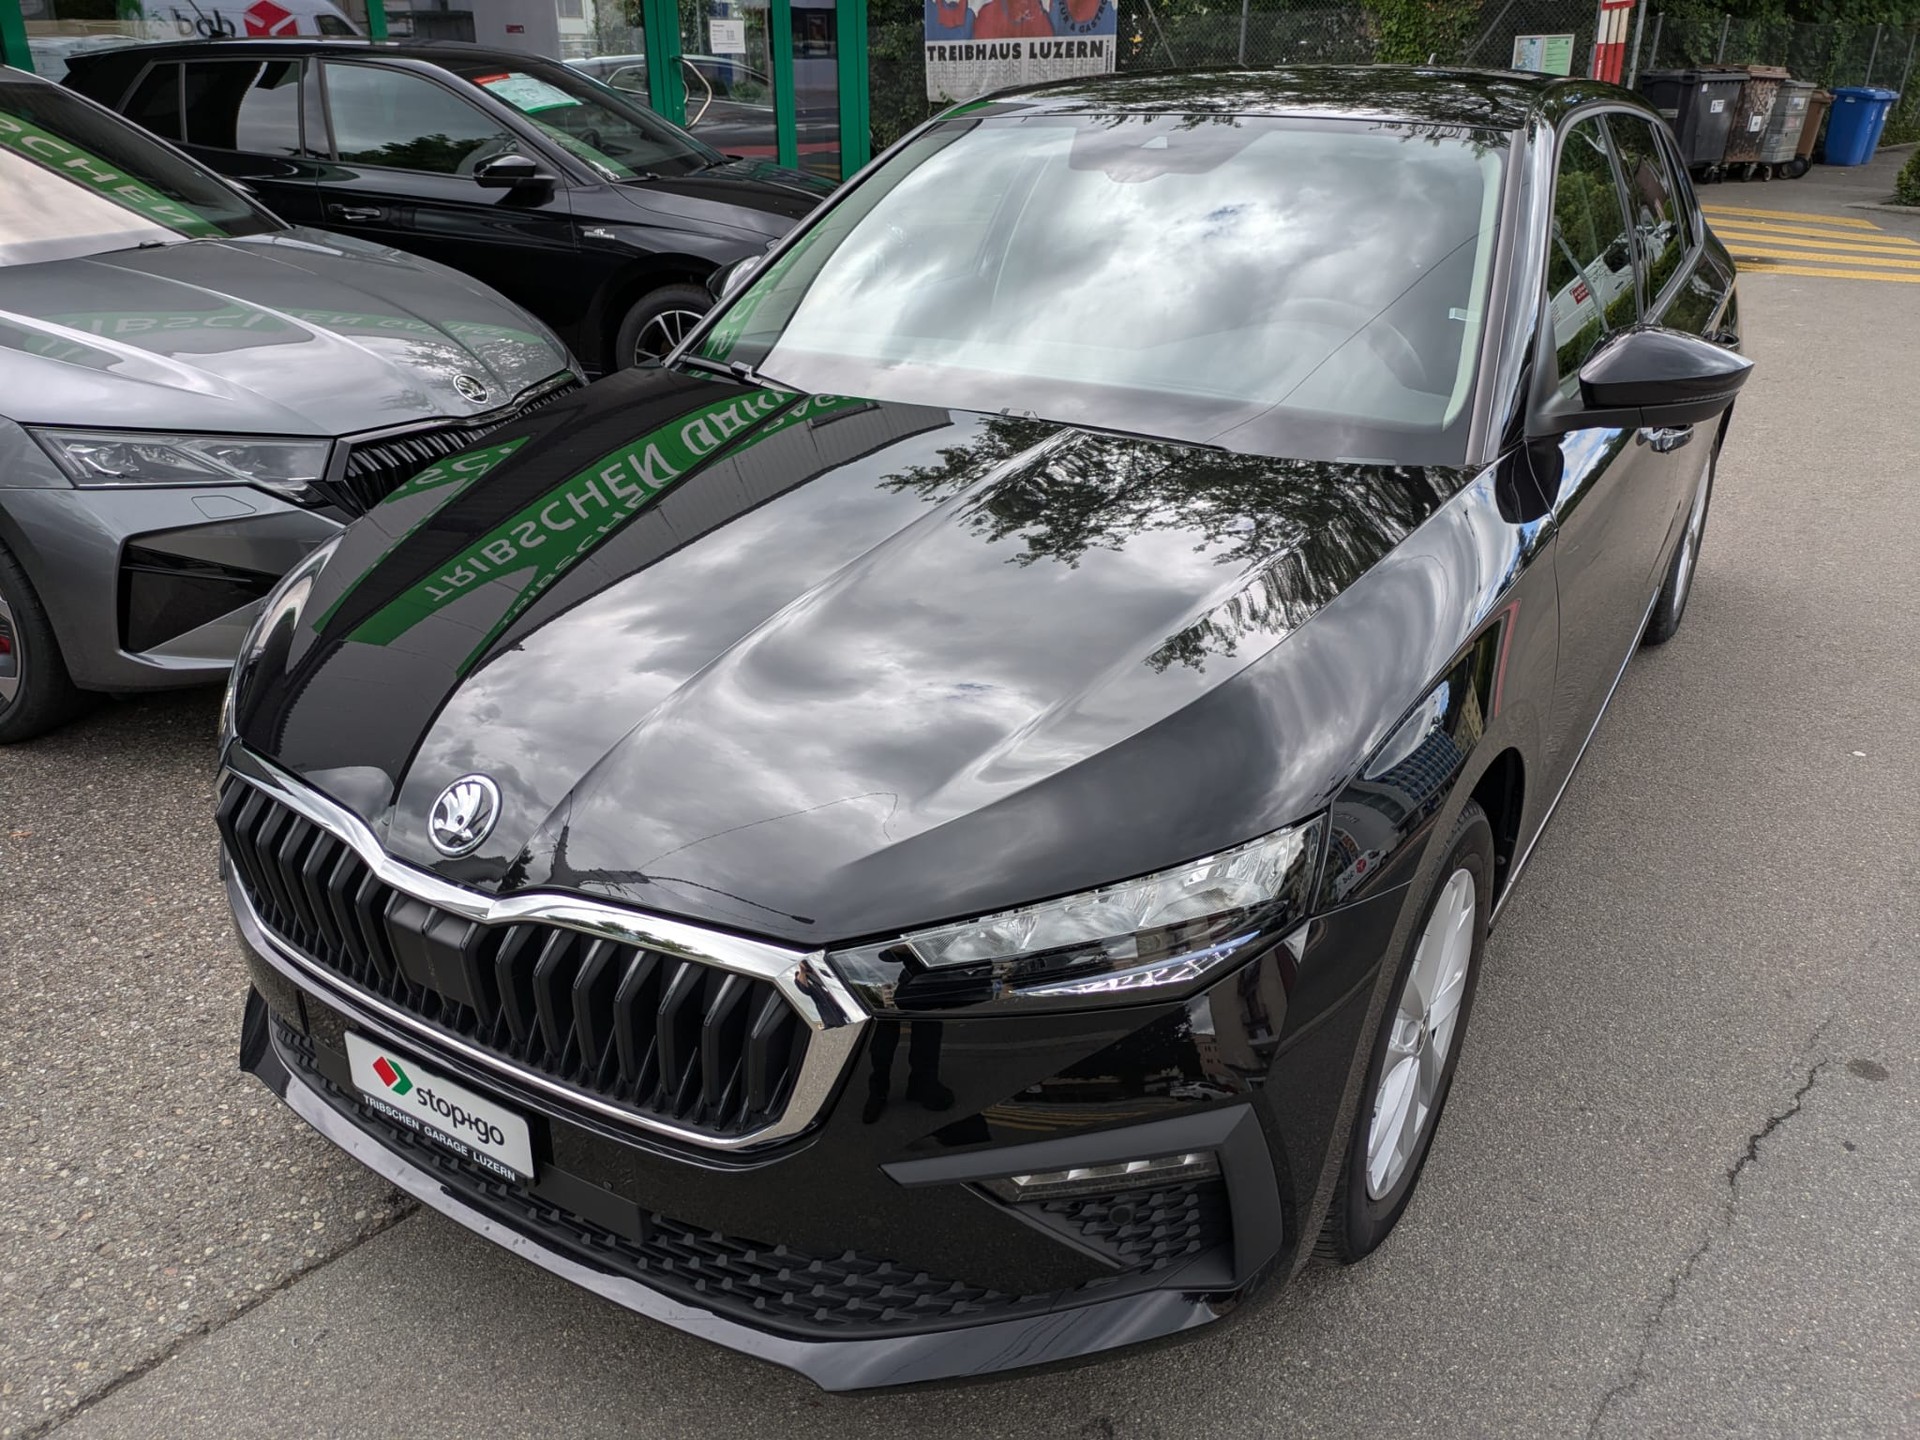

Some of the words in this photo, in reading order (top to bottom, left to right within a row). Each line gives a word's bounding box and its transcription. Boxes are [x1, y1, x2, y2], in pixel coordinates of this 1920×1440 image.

[927, 43, 1021, 62] TREIBHAUS
[1029, 40, 1103, 59] LUZERN
[363, 1094, 419, 1131] TRIBSCHEN
[424, 1126, 468, 1156] GARAGE
[473, 1152, 515, 1181] LUZERN
[416, 1086, 505, 1146] stop+go
